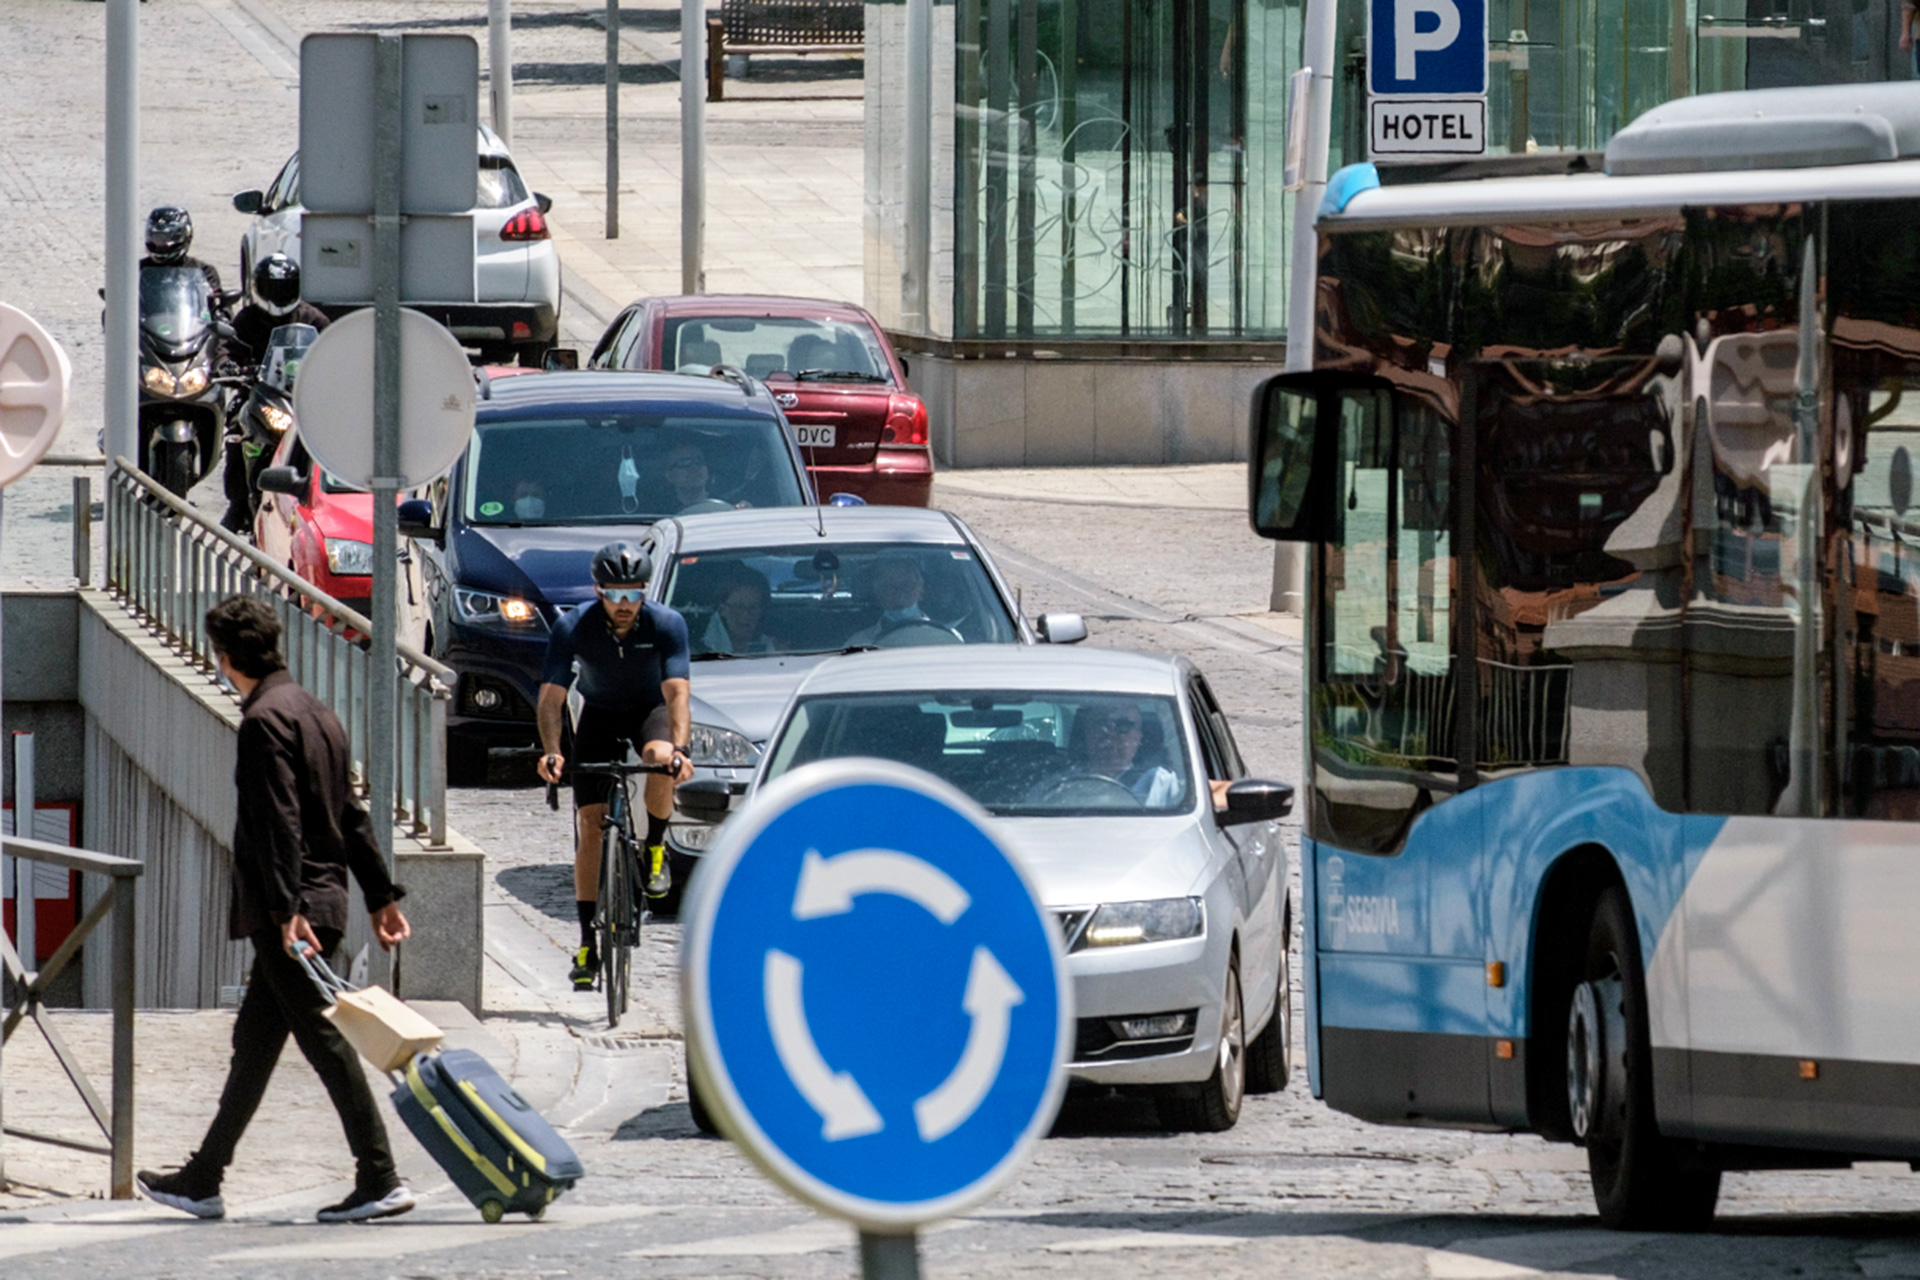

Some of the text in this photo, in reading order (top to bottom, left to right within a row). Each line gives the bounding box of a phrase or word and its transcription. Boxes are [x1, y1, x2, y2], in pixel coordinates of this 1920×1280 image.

[1394, 0, 1461, 80] P
[1383, 114, 1473, 140] HOTEL
[798, 427, 831, 444] DVC
